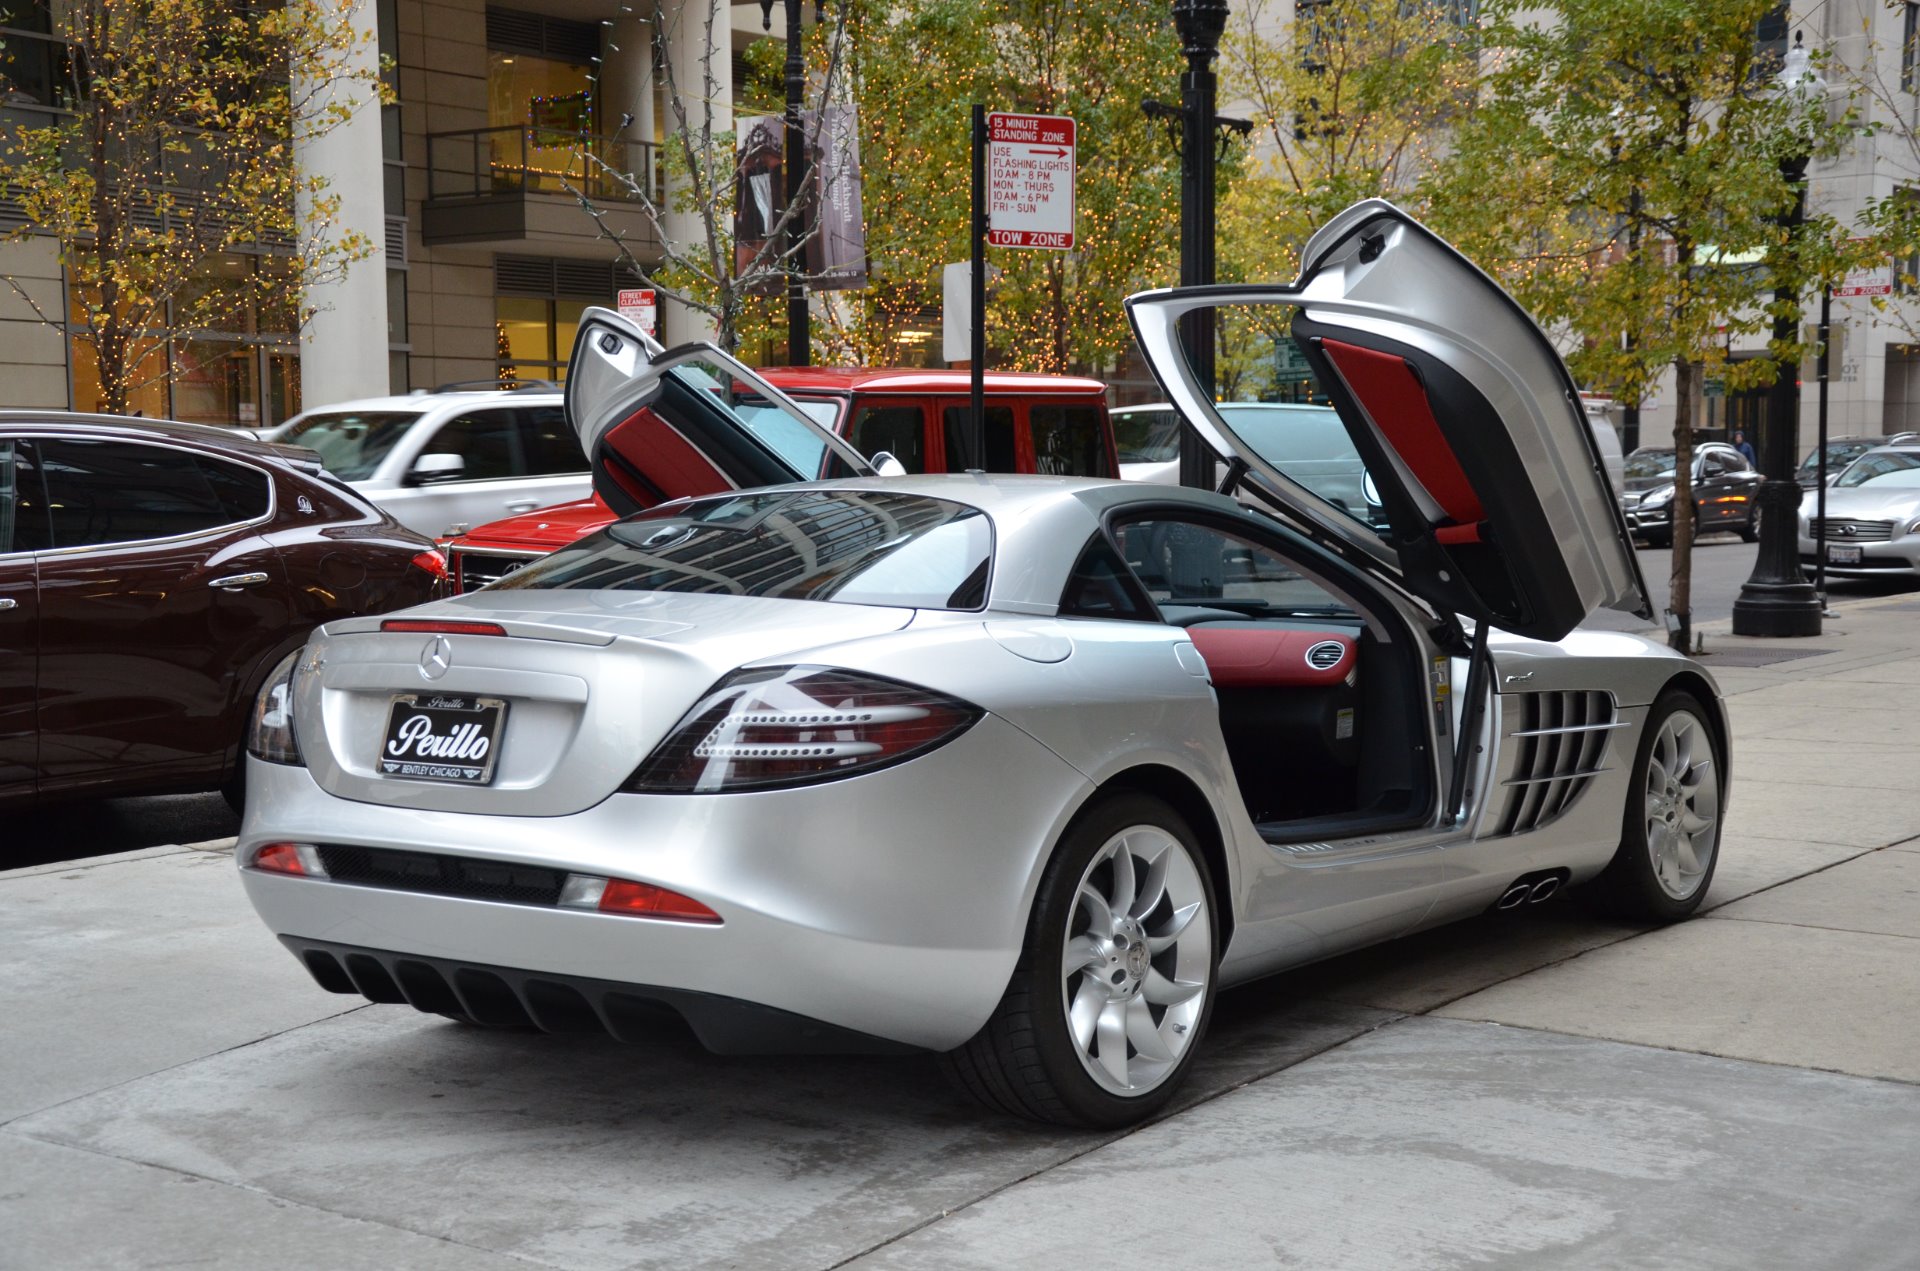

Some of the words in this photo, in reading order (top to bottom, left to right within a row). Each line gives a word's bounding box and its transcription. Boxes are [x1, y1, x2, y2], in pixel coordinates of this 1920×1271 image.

[994, 118, 1003, 128] 15
[1006, 118, 1039, 130] MINUTE
[994, 129, 1037, 141] STANDING
[1042, 131, 1065, 143] ZONE
[993, 146, 1012, 157] USE
[993, 158, 1037, 170] FLASHING
[1039, 160, 1070, 172] LIGHTS
[993, 169, 1003, 179] 10
[1005, 169, 1019, 180] AM
[1028, 171, 1034, 180] 8
[1037, 171, 1051, 181] PM
[993, 180, 1014, 190] MON
[1024, 181, 1055, 193] THURS
[993, 190, 1003, 201] 10
[1004, 191, 1018, 202] AM
[1028, 193, 1034, 203] 6
[1036, 193, 1049, 203] PM
[993, 202, 1009, 212] FRI
[1017, 203, 1037, 214] SUN
[993, 231, 1023, 244] TOW
[1029, 233, 1066, 247] ZONE
[1860, 286, 1886, 295] ZONE
[621, 298, 651, 306] CLEANING
[428, 696, 465, 709] Perillo
[388, 714, 490, 760] Perillo
[401, 764, 429, 776] BENTLEY
[429, 766, 461, 778] CHICAGO
